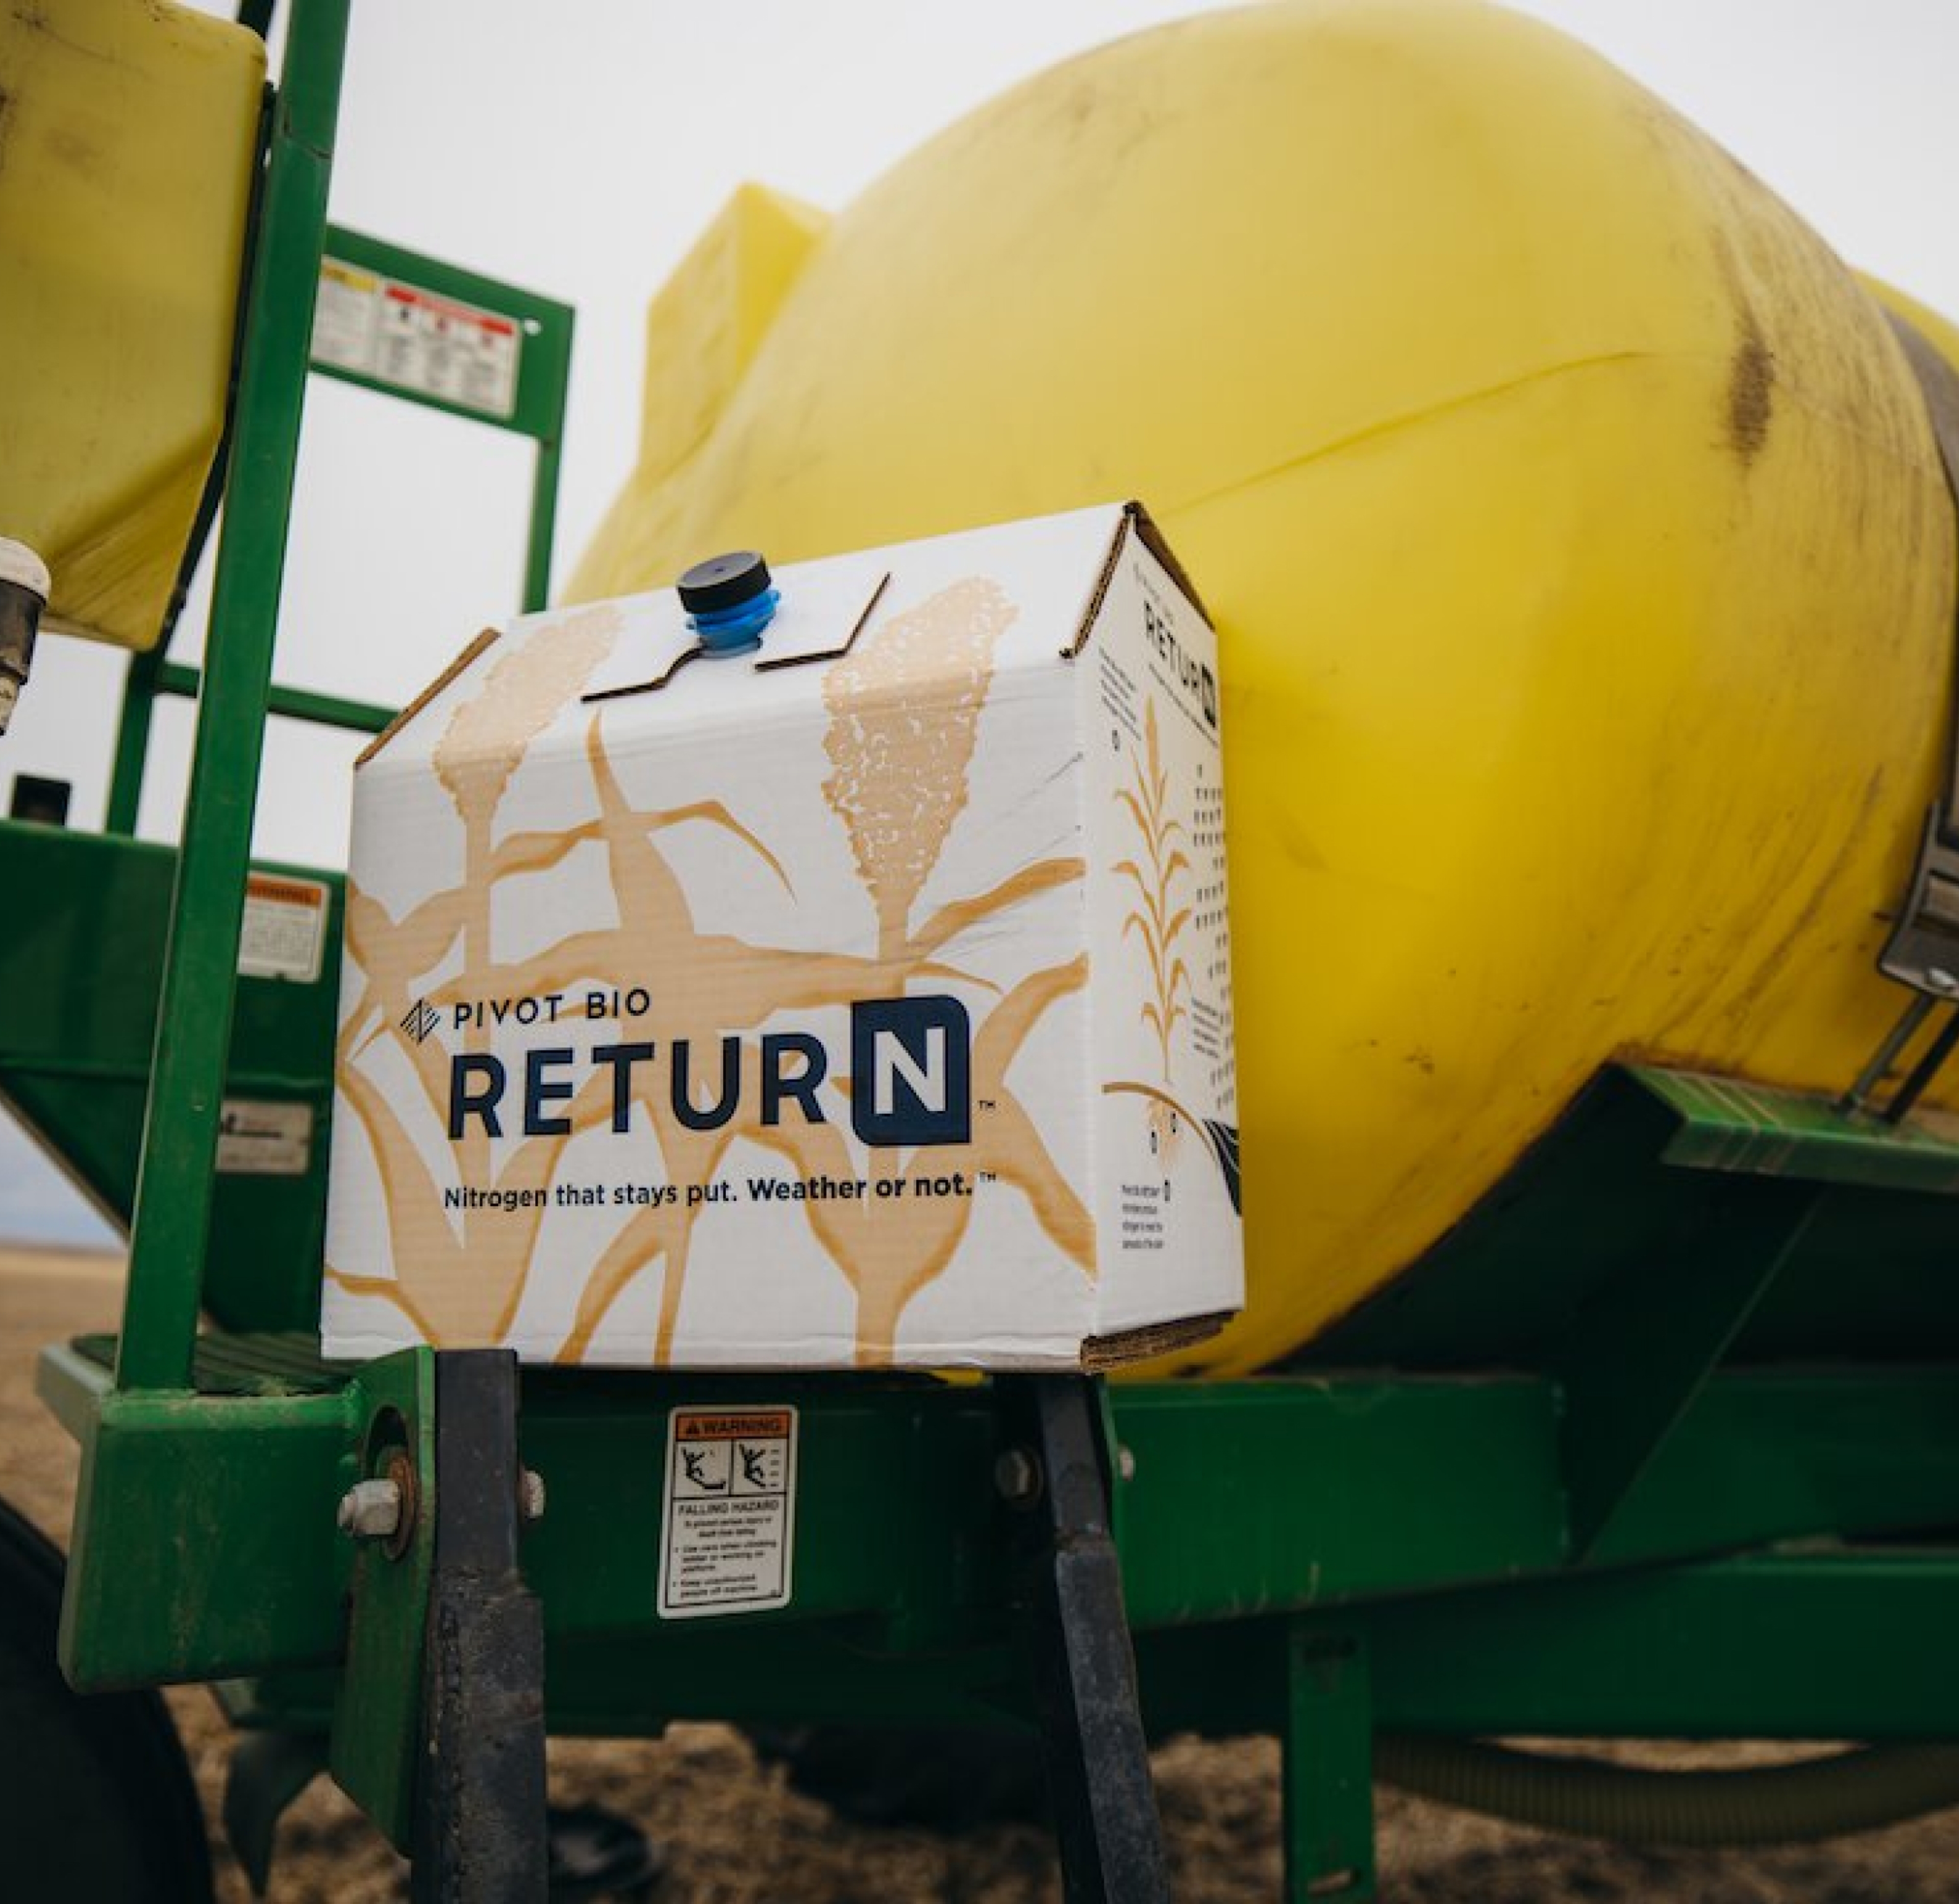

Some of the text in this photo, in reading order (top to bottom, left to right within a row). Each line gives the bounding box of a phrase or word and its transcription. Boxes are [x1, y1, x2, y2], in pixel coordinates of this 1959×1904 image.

[454, 988, 650, 1029] PIVOT BIO
[445, 1184, 547, 1212] Nitrogen
[556, 1183, 605, 1207] that
[614, 1183, 677, 1209] stays
[686, 1180, 737, 1207] put.
[747, 1175, 867, 1202] Weather
[875, 1179, 906, 1197] or
[701, 1418, 779, 1435] WARNING
[678, 1500, 780, 1515] FALLING HAZARD
